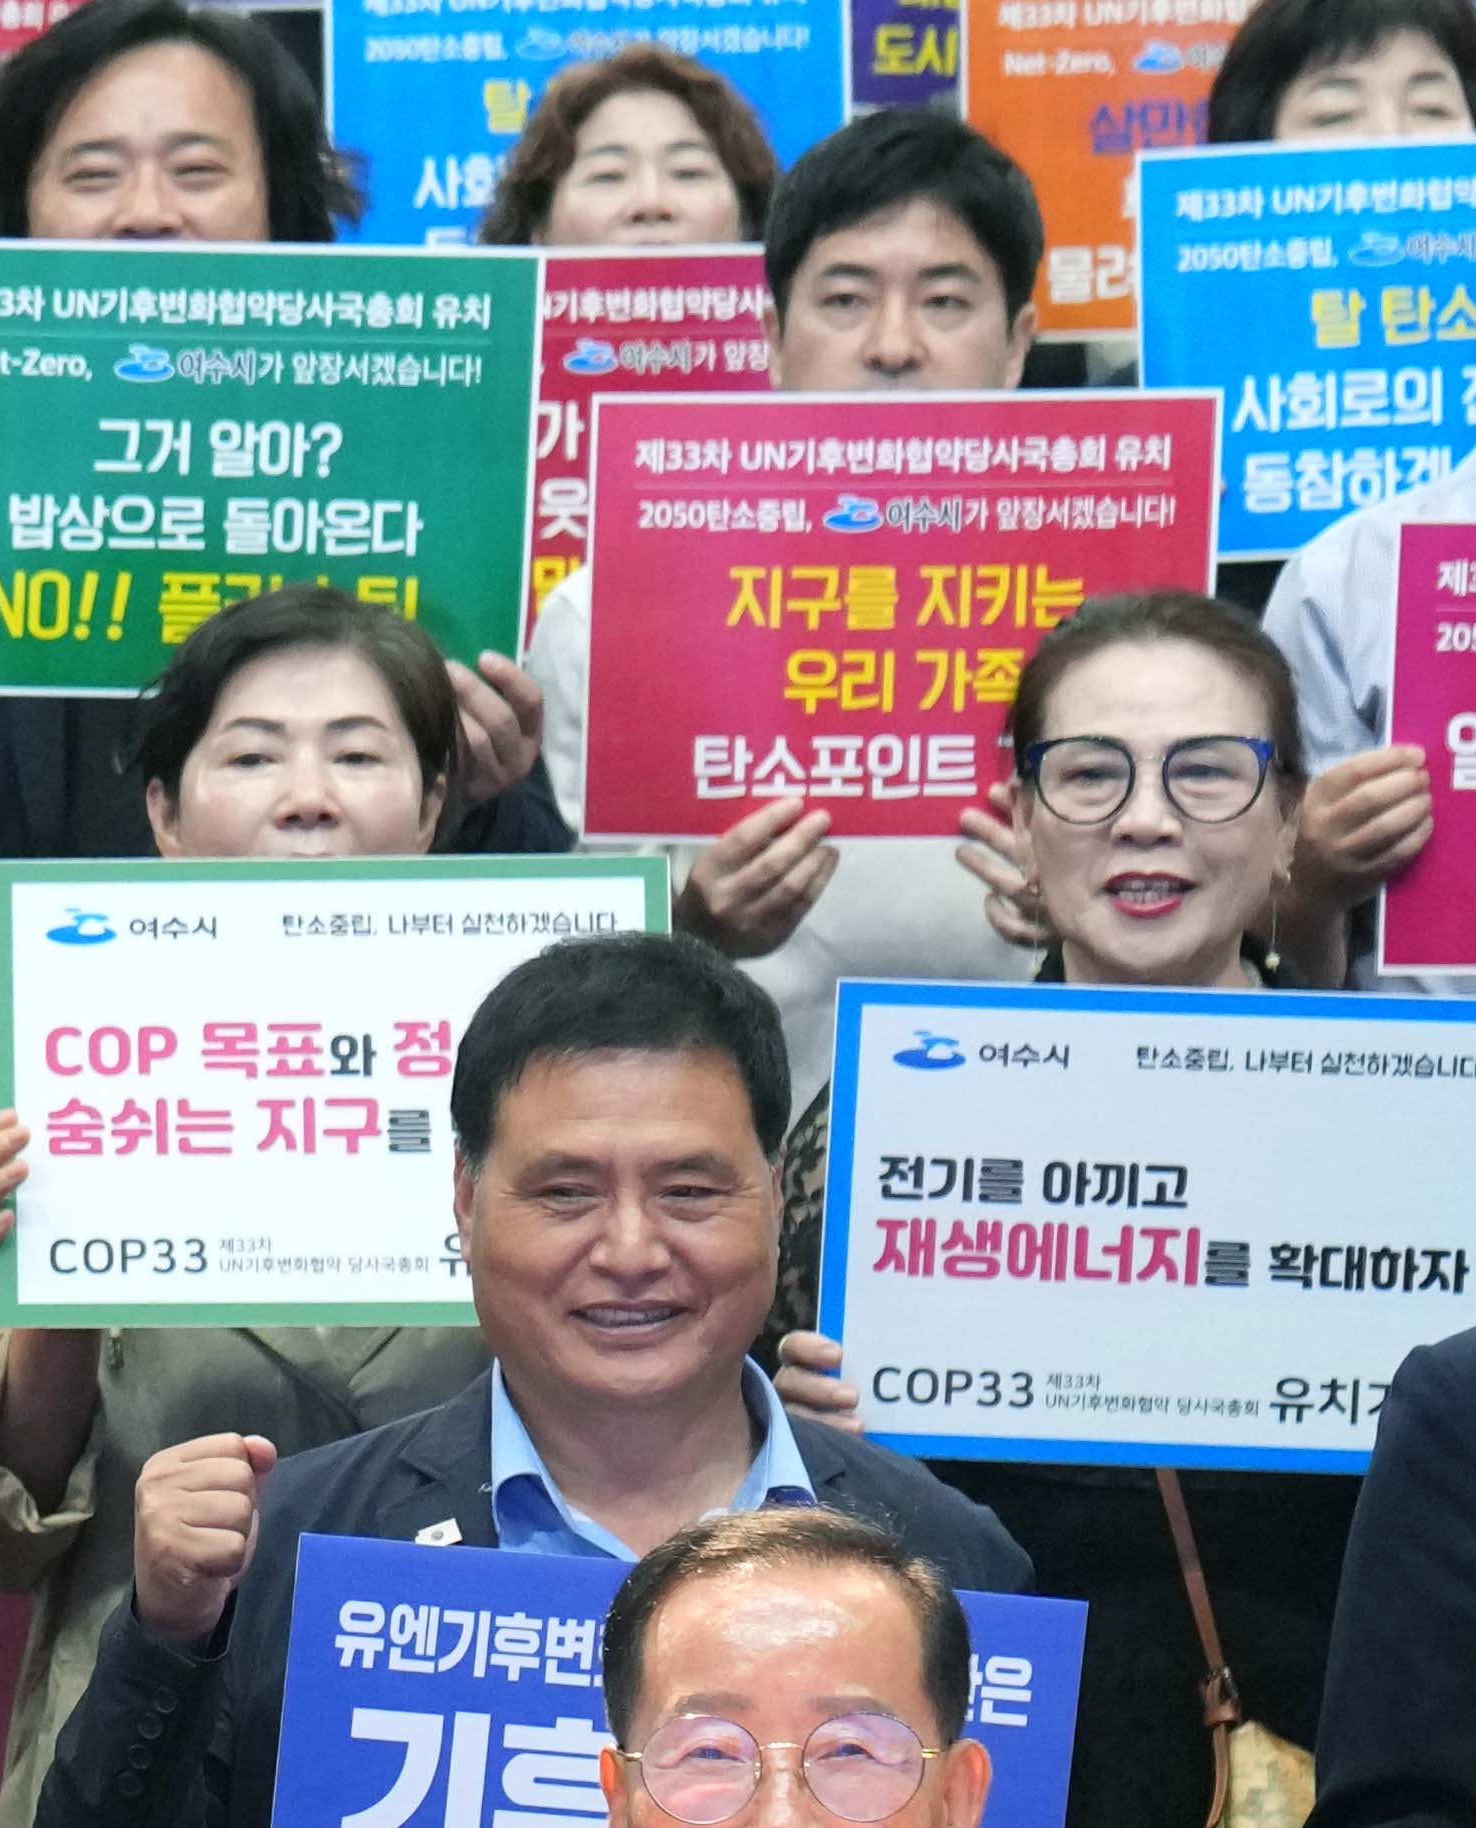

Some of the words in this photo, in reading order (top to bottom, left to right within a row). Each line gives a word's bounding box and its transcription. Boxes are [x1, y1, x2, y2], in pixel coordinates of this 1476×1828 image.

[432, 294, 491, 330] 유치
[292, 347, 482, 386] 앞장서겠습니다!
[1232, 366, 1443, 432] 사회로의
[94, 418, 192, 475] 그거
[209, 419, 343, 479] 알아?
[635, 438, 732, 475] 제33차
[1115, 433, 1171, 472] 유치
[9, 493, 207, 553] 밥상으로
[224, 499, 424, 557] 돌아온다
[996, 497, 1176, 532] 앞장서겠습니다!
[726, 567, 899, 631] 지구를
[915, 565, 1085, 630] 지키는
[783, 650, 894, 714] 우리
[915, 649, 1025, 713] 가족
[693, 733, 977, 801] 탄소포인트
[129, 915, 219, 941] 여수시
[388, 911, 454, 936] 나부터
[461, 911, 619, 938] 실천하겠습니다
[44, 1024, 177, 1078] COP
[201, 1021, 377, 1079] 목표와
[978, 1044, 1070, 1070] 여수시
[1244, 1049, 1312, 1075] 나부터
[46, 1097, 234, 1157] 숨쉬는
[257, 1096, 431, 1156] 지구를
[878, 1155, 1024, 1205] 전기를
[1042, 1161, 1188, 1210] 아끼고
[49, 1237, 208, 1275] COP33
[219, 1237, 272, 1254] 제33차
[219, 1256, 342, 1274] UN기후변화협약
[348, 1256, 429, 1274] 당사국총회
[872, 1217, 1251, 1288] 재생에너지를
[1269, 1242, 1469, 1295] 확대하자
[872, 1367, 1035, 1409] COP33
[1047, 1372, 1101, 1391] 제33차
[1044, 1395, 1170, 1415] UN기후변화협약
